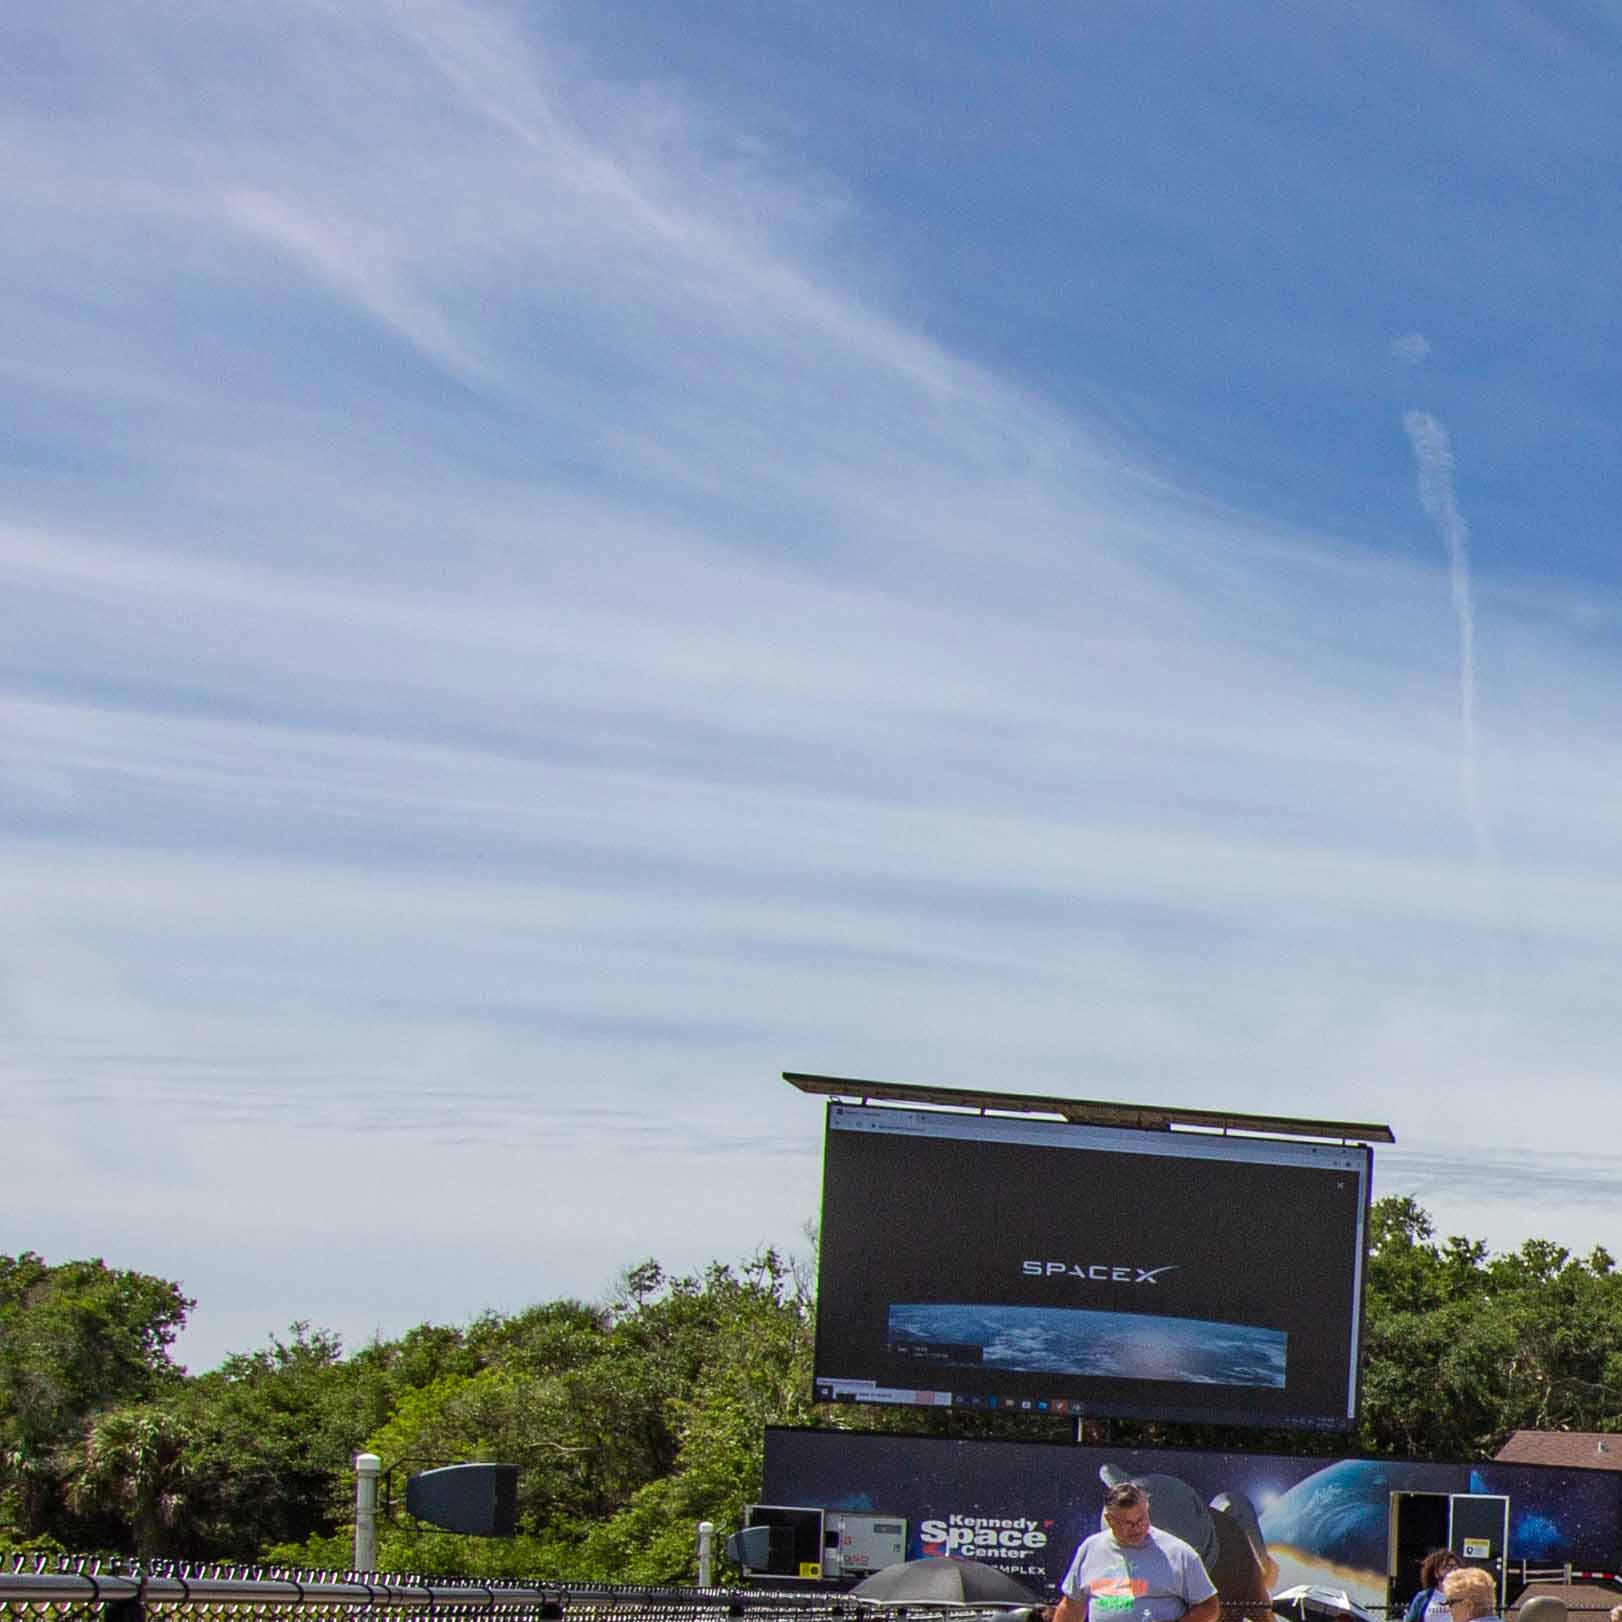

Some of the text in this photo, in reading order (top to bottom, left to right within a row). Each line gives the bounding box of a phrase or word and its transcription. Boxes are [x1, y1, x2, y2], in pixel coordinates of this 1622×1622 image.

[1023, 1261, 1181, 1284] SPACEX
[950, 1514, 1038, 1531] Kennedy
[920, 1520, 1048, 1549] Space
[961, 1545, 1028, 1559] Center
